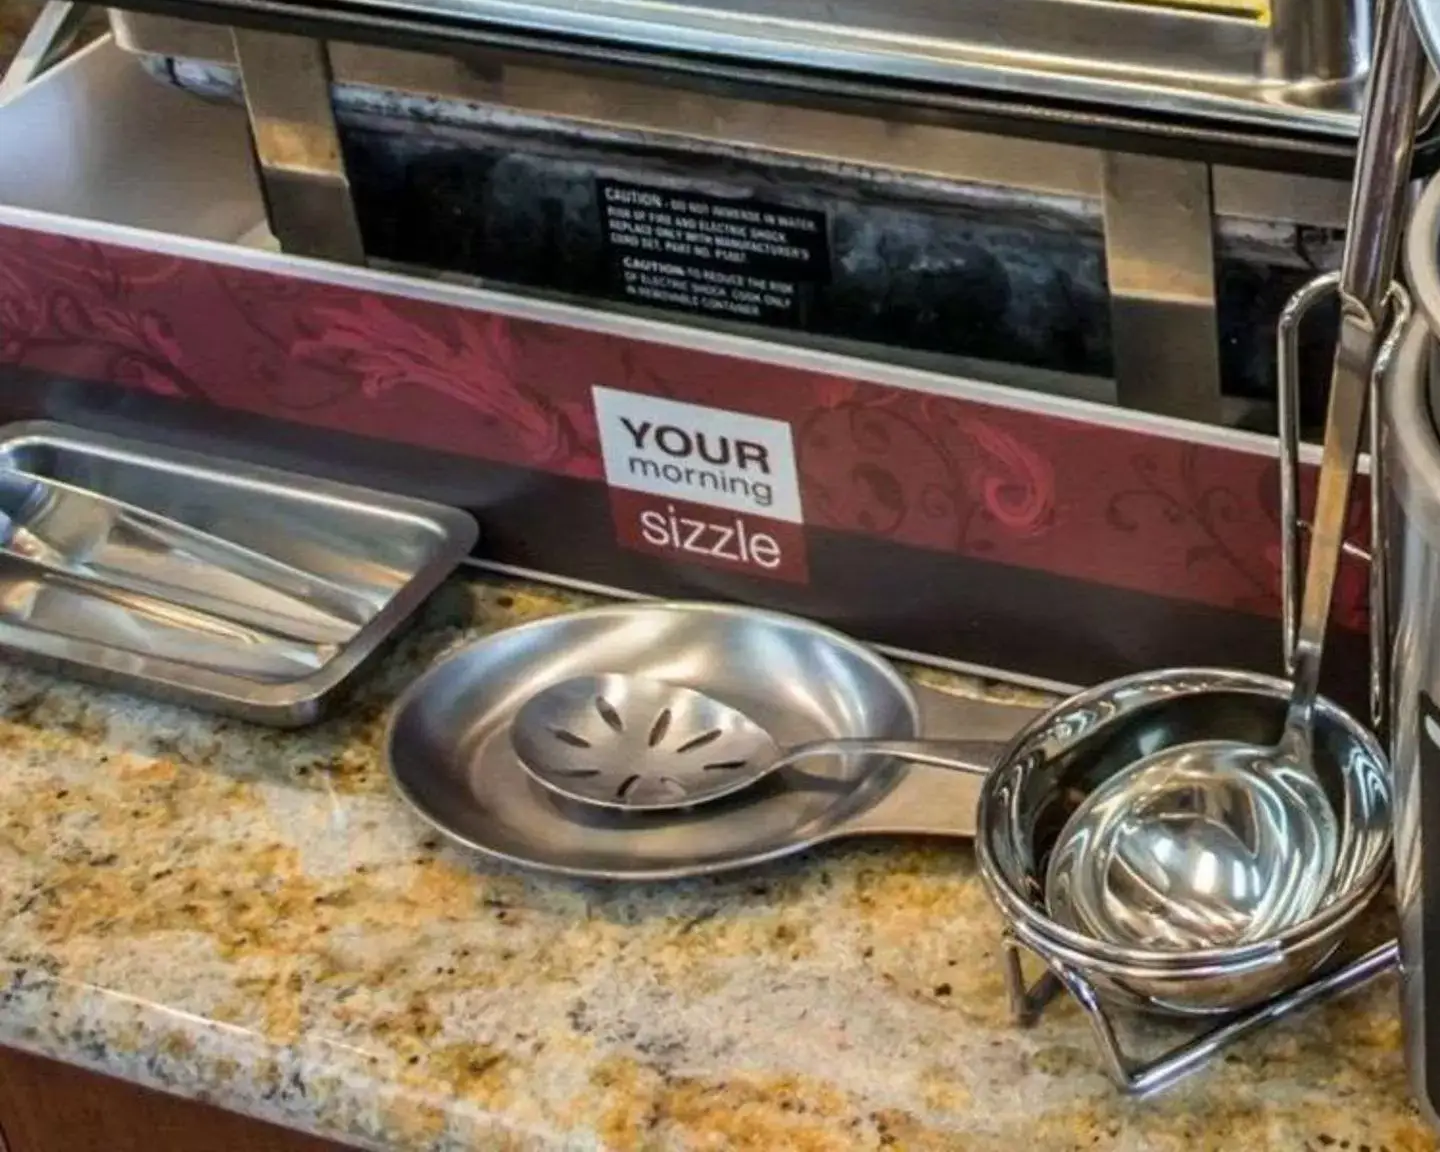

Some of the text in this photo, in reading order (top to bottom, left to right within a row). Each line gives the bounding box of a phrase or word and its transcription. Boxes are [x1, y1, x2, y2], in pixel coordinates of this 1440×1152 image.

[605, 187, 662, 208] CAUTION
[688, 202, 709, 216] NOT
[675, 216, 697, 230] AND
[619, 416, 771, 475] YOUR
[628, 455, 774, 507] morning
[640, 504, 782, 568] sizzle
